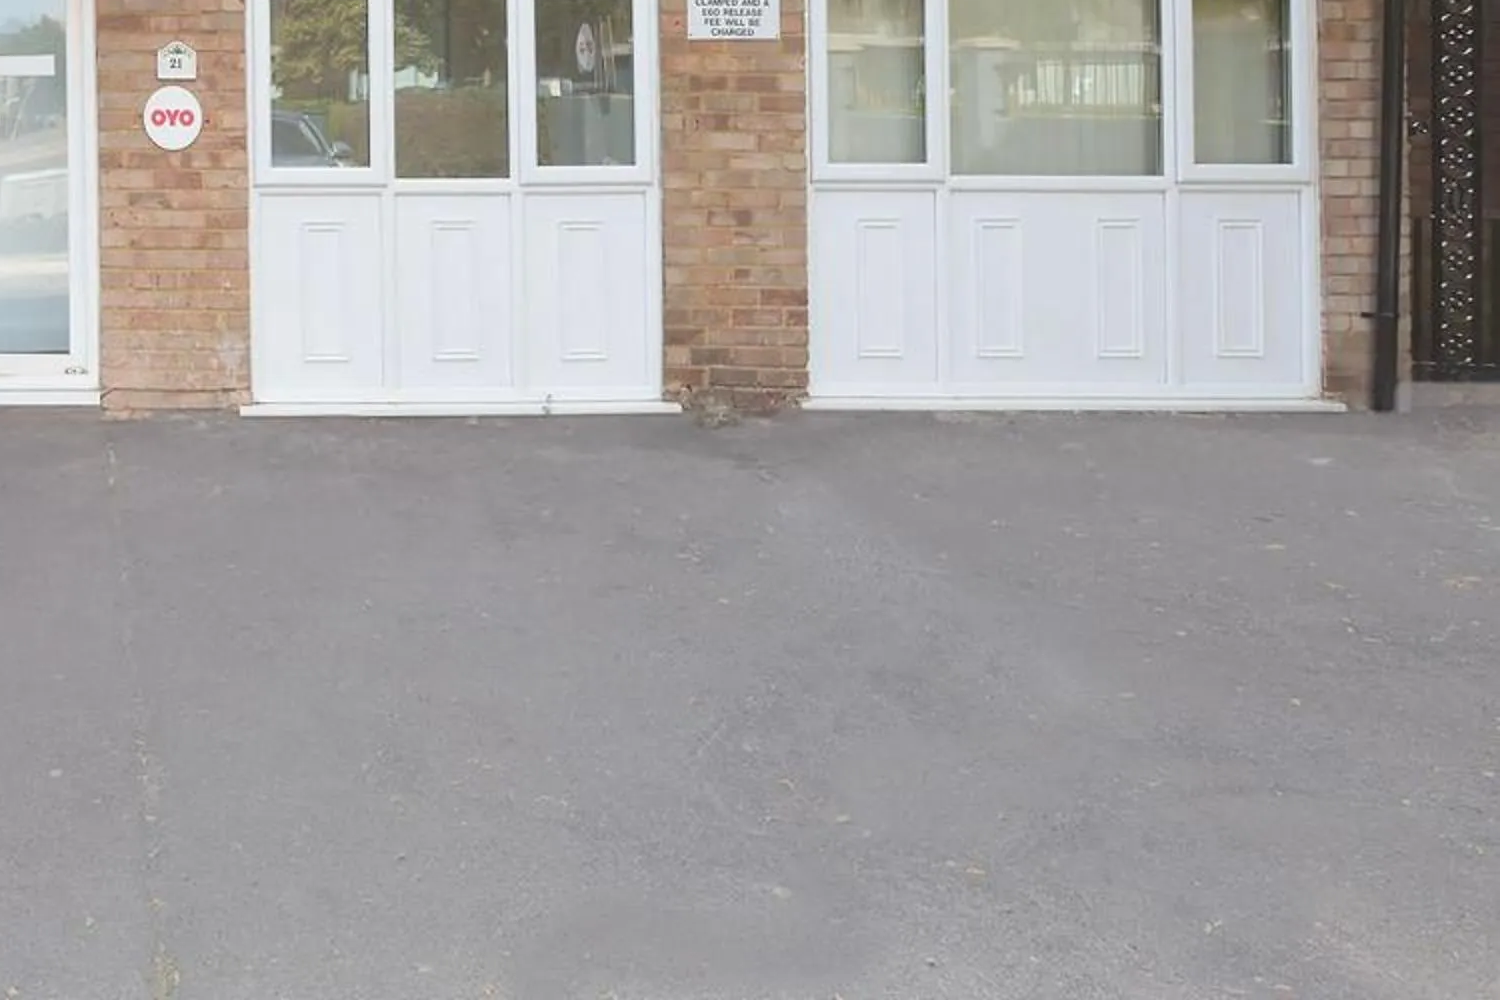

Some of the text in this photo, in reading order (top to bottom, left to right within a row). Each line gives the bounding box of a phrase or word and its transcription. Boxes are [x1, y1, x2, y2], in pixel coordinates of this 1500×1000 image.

[723, 7, 763, 17] RELEASE
[703, 18, 760, 27] FEE WILL BE
[711, 27, 755, 37] CHARGED
[169, 58, 183, 69] 21
[151, 109, 195, 127] OYO
